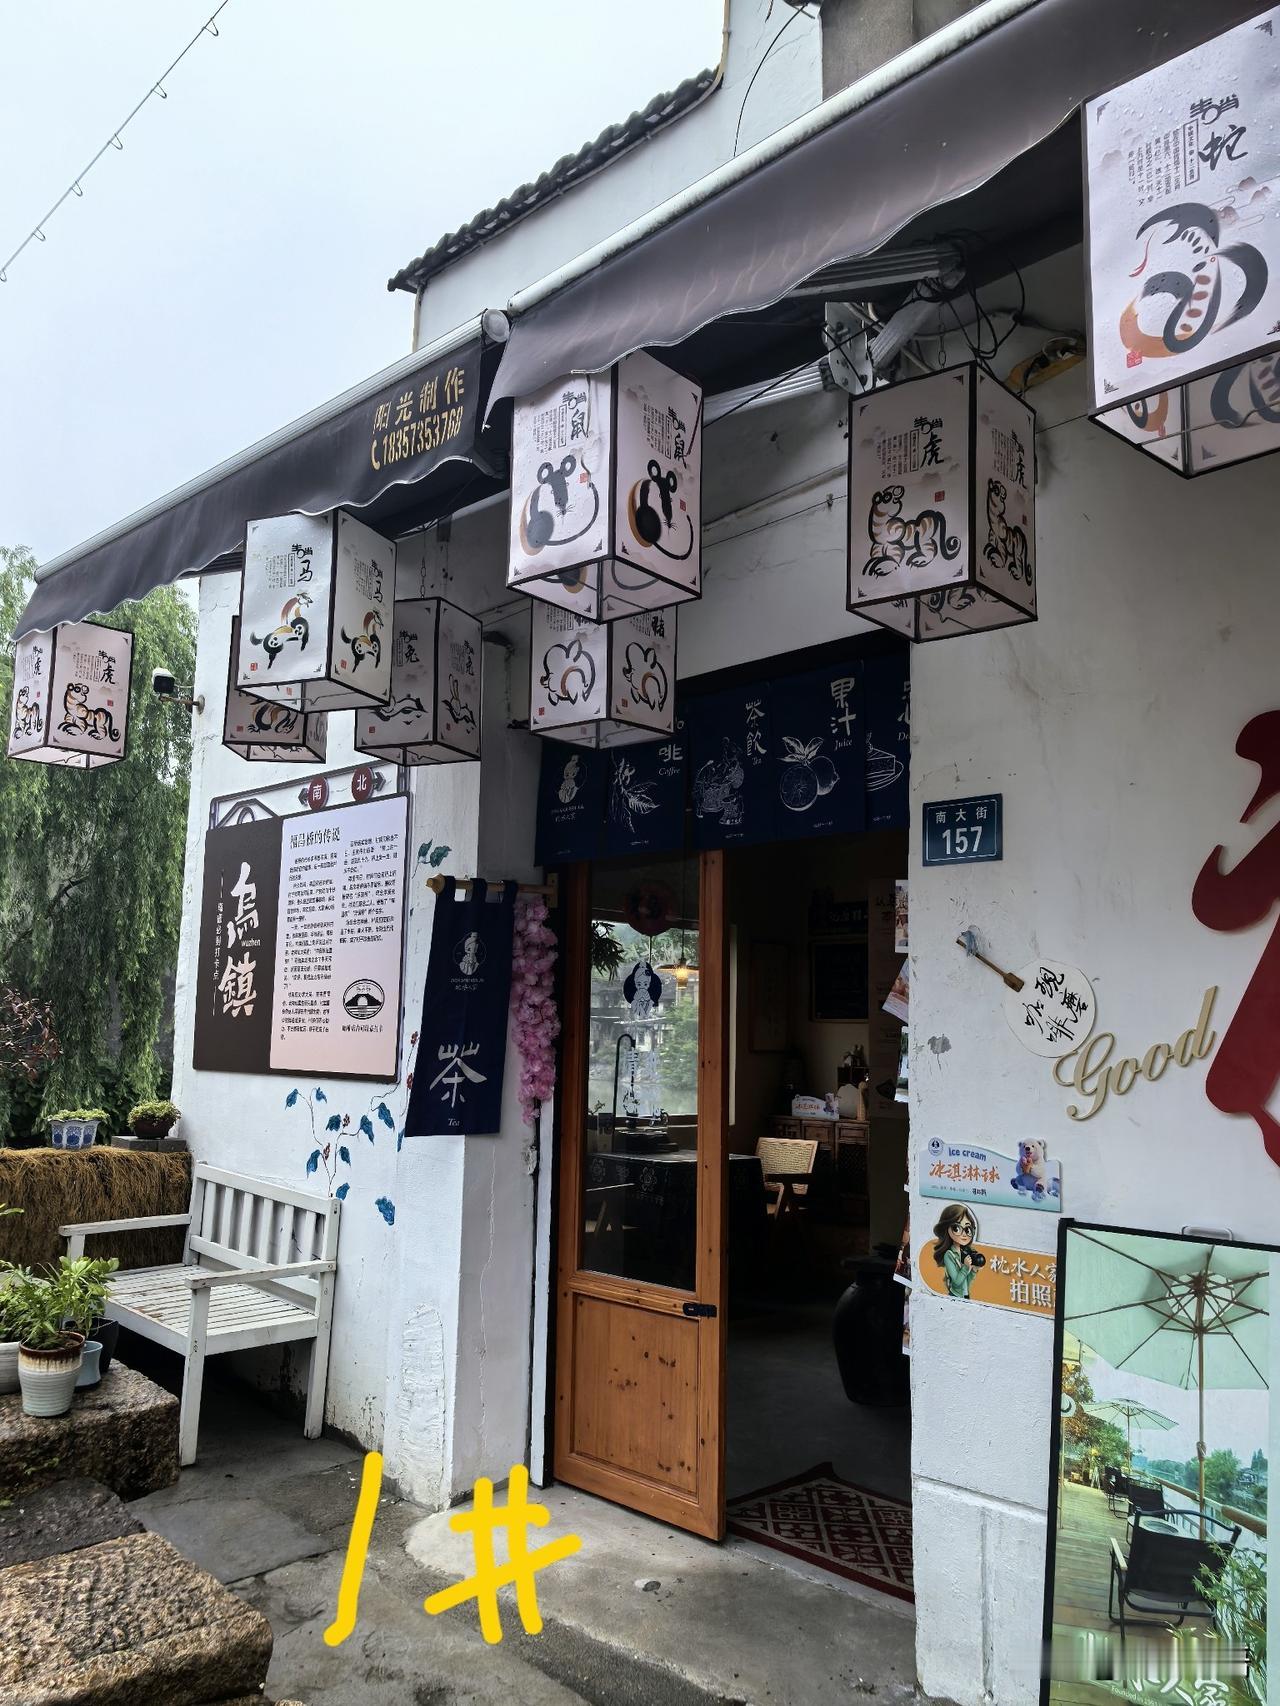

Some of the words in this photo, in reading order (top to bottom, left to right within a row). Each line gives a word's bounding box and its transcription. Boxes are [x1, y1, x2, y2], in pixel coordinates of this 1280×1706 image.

[1198, 124, 1248, 171] 蛇
[373, 367, 465, 434] 阳光制作
[570, 409, 588, 440] 鼠
[920, 432, 944, 467] 虎
[297, 559, 313, 582] 马
[100, 664, 116, 684] 虎
[830, 677, 856, 736] 果汁
[834, 738, 853, 751] Juice
[356, 775, 367, 791] 北
[658, 766, 681, 777] Coffee
[312, 784, 322, 799] 南
[935, 806, 988, 824] 南大街
[942, 826, 983, 855] 157
[1053, 985, 1218, 1121] Good
[430, 1042, 487, 1108] 茶
[948, 1147, 961, 1157] Ice
[962, 1149, 987, 1162] cream
[1010, 1279, 1056, 1307] 拍照
